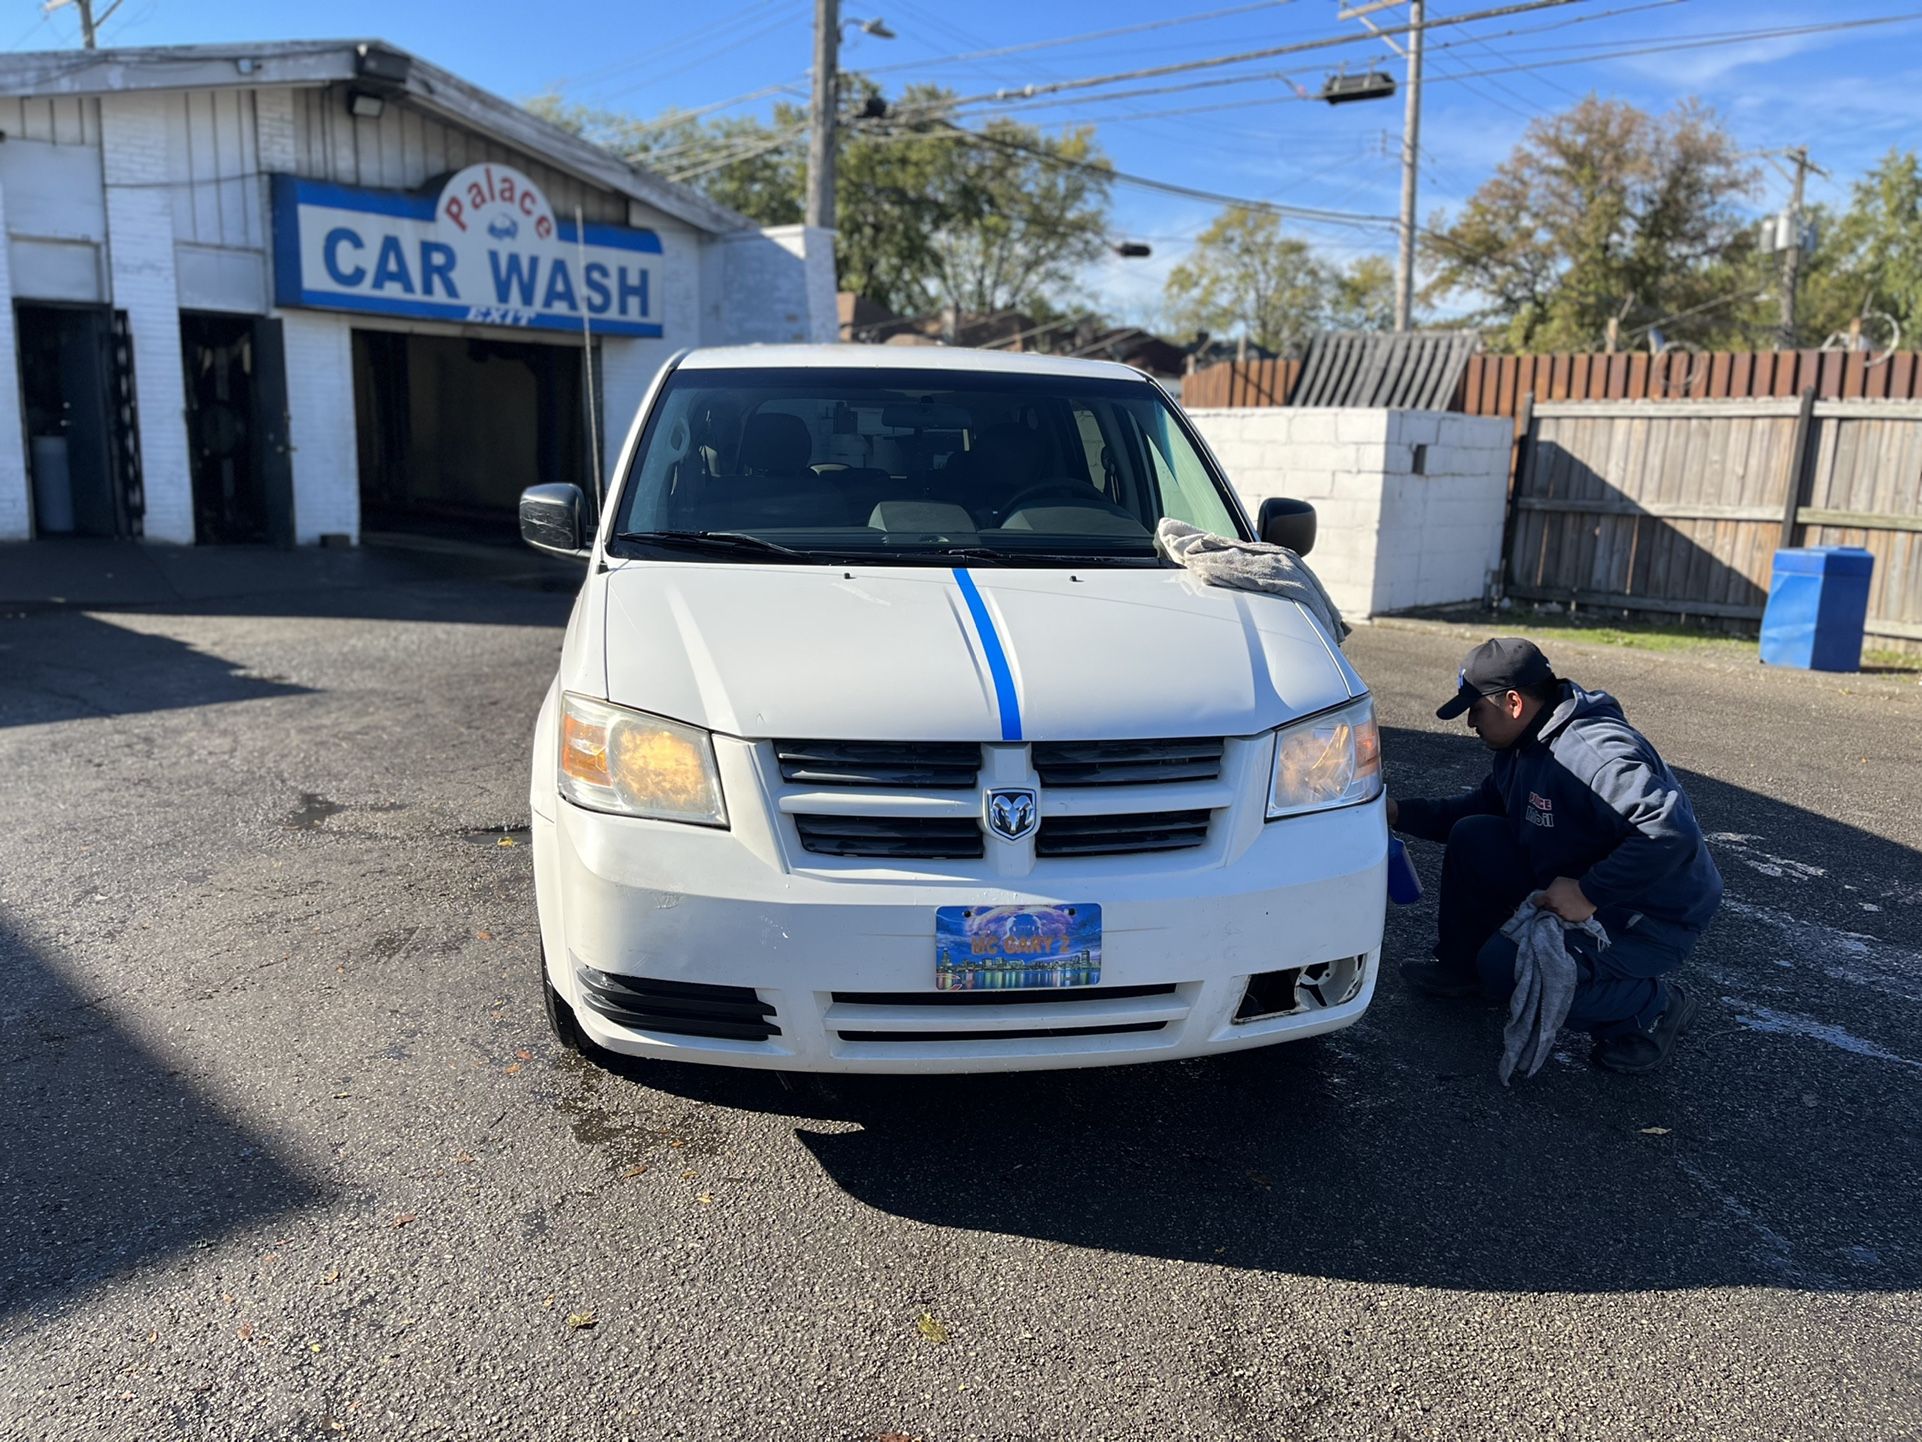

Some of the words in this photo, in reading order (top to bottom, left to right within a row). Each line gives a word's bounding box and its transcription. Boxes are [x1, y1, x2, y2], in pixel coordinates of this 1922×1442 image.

[445, 166, 552, 240] Palace
[323, 227, 460, 299] CAR
[488, 249, 650, 318] WASH
[465, 306, 537, 327] EXIT
